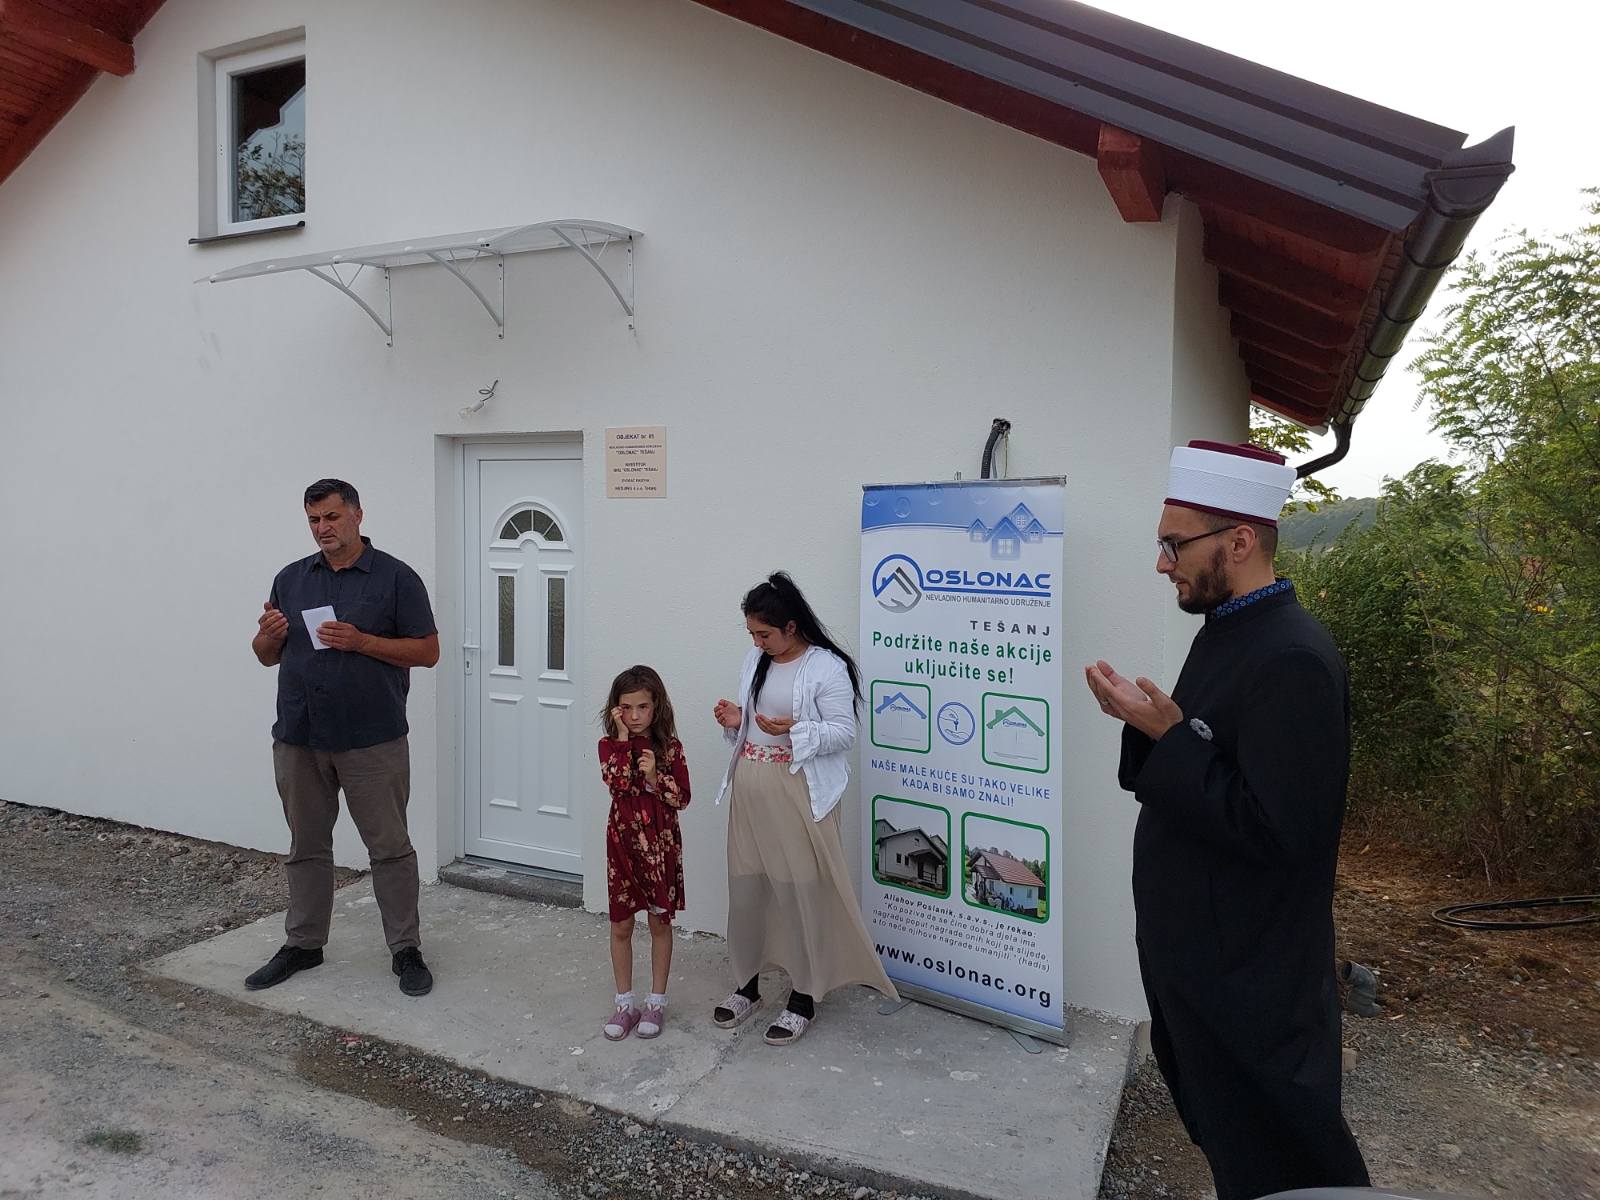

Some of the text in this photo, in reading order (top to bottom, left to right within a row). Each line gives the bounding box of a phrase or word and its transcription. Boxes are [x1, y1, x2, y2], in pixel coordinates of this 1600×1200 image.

[925, 569, 1052, 589] OSLONAC
[925, 593, 1052, 608] NEVLADINO HUMANITARNO UDRUŽENJE
[872, 631, 1052, 665] Podržite naše akcije
[905, 658, 1014, 684] uključite se!
[871, 758, 1051, 800] NAŠE MALE KUĆE SU TAKO VELIKE
[902, 779, 1014, 807] KADA BI SAMO ZNALI!
[872, 909, 904, 922] nagradu
[905, 917, 928, 928] poput
[929, 924, 963, 937] nagrade
[965, 933, 983, 943] onih
[985, 937, 1001, 949] koji
[1003, 943, 1014, 952] ga
[883, 893, 914, 906] Allahov
[917, 901, 956, 918] Poslanik,
[995, 921, 1005, 930] je
[1007, 925, 1036, 938] rekao:
[899, 906, 925, 918] poziva
[926, 913, 937, 921] da
[950, 918, 968, 930] čine
[969, 925, 994, 937] dobra
[996, 930, 1018, 942] djela
[1020, 938, 1036, 948] ima
[878, 918, 887, 926] to
[908, 927, 937, 940] njihove
[939, 935, 973, 950] nagrade
[1018, 957, 1050, 973] (hadis)
[874, 943, 1052, 1008] www.oslonac.org
